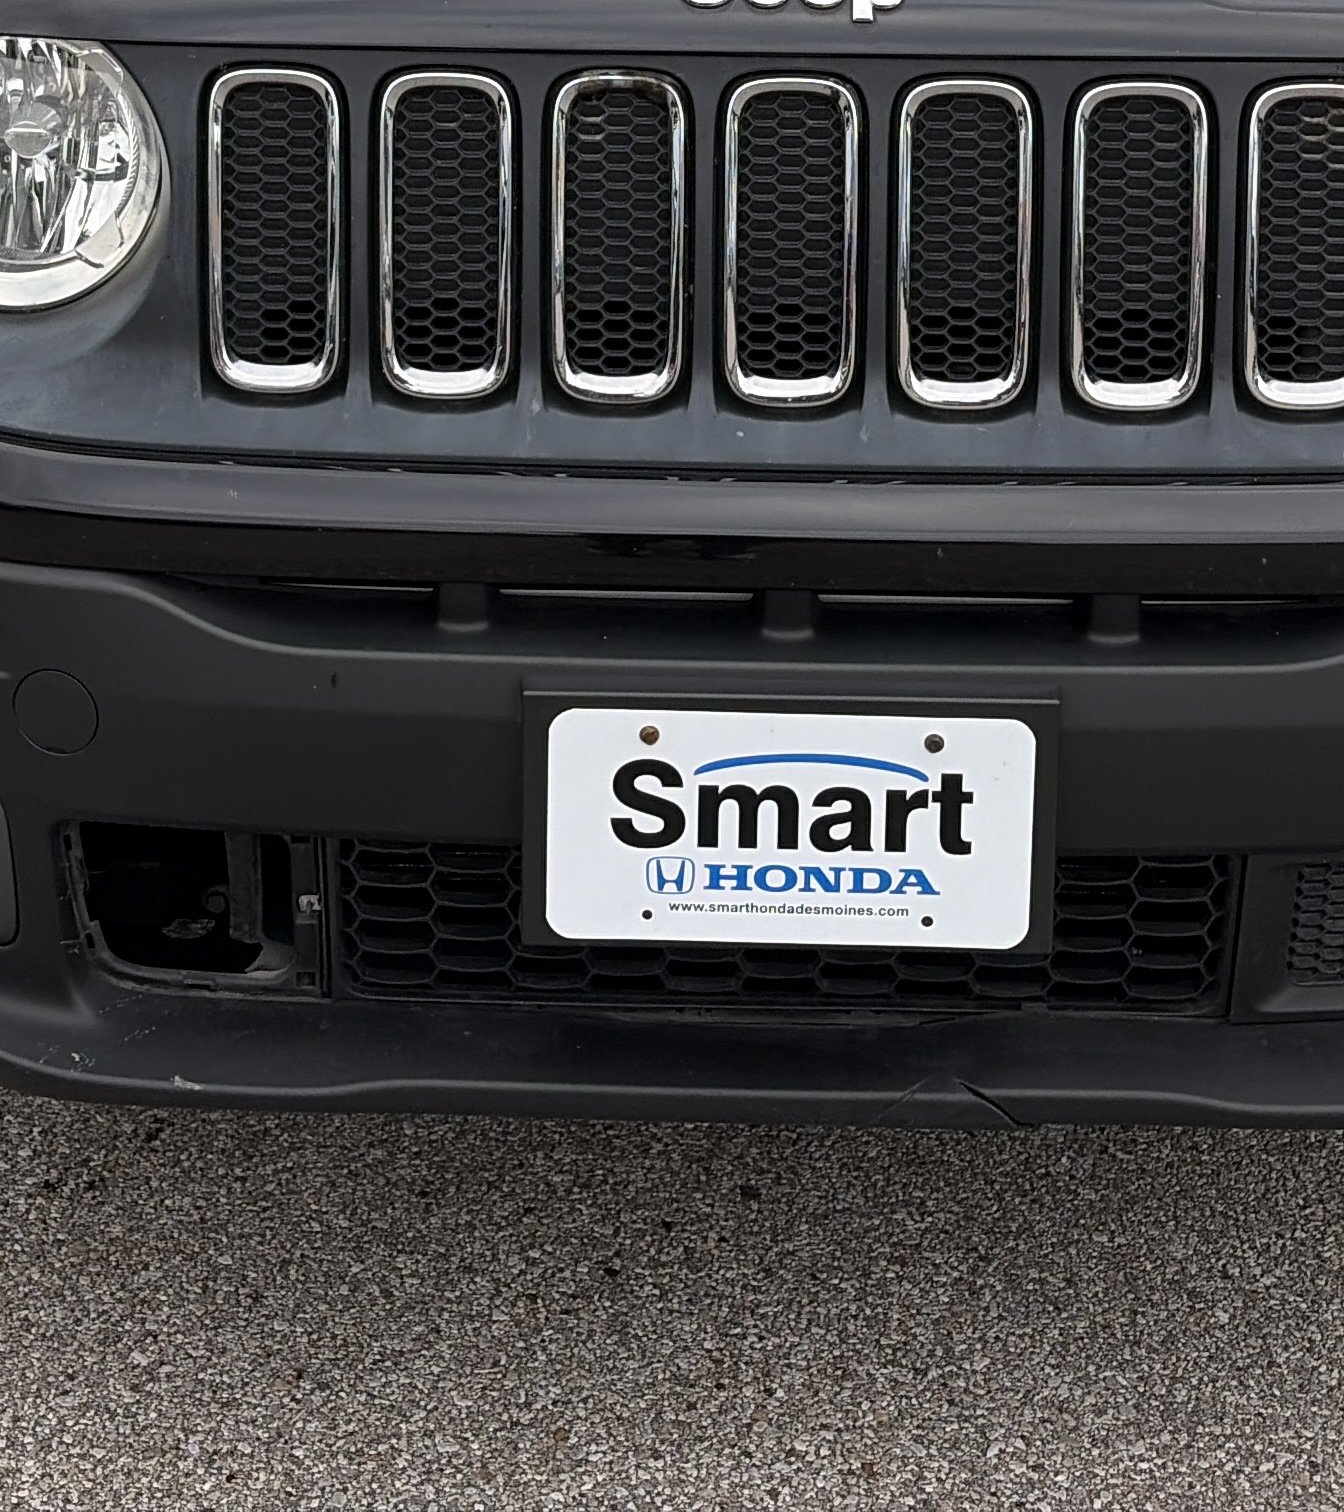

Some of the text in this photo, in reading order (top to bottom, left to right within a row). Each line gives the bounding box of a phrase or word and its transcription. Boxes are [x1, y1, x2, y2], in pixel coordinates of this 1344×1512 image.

[610, 759, 974, 855] Smart
[703, 864, 941, 896] HONDA
[668, 901, 910, 918] www.smarthondadesmoines.com
